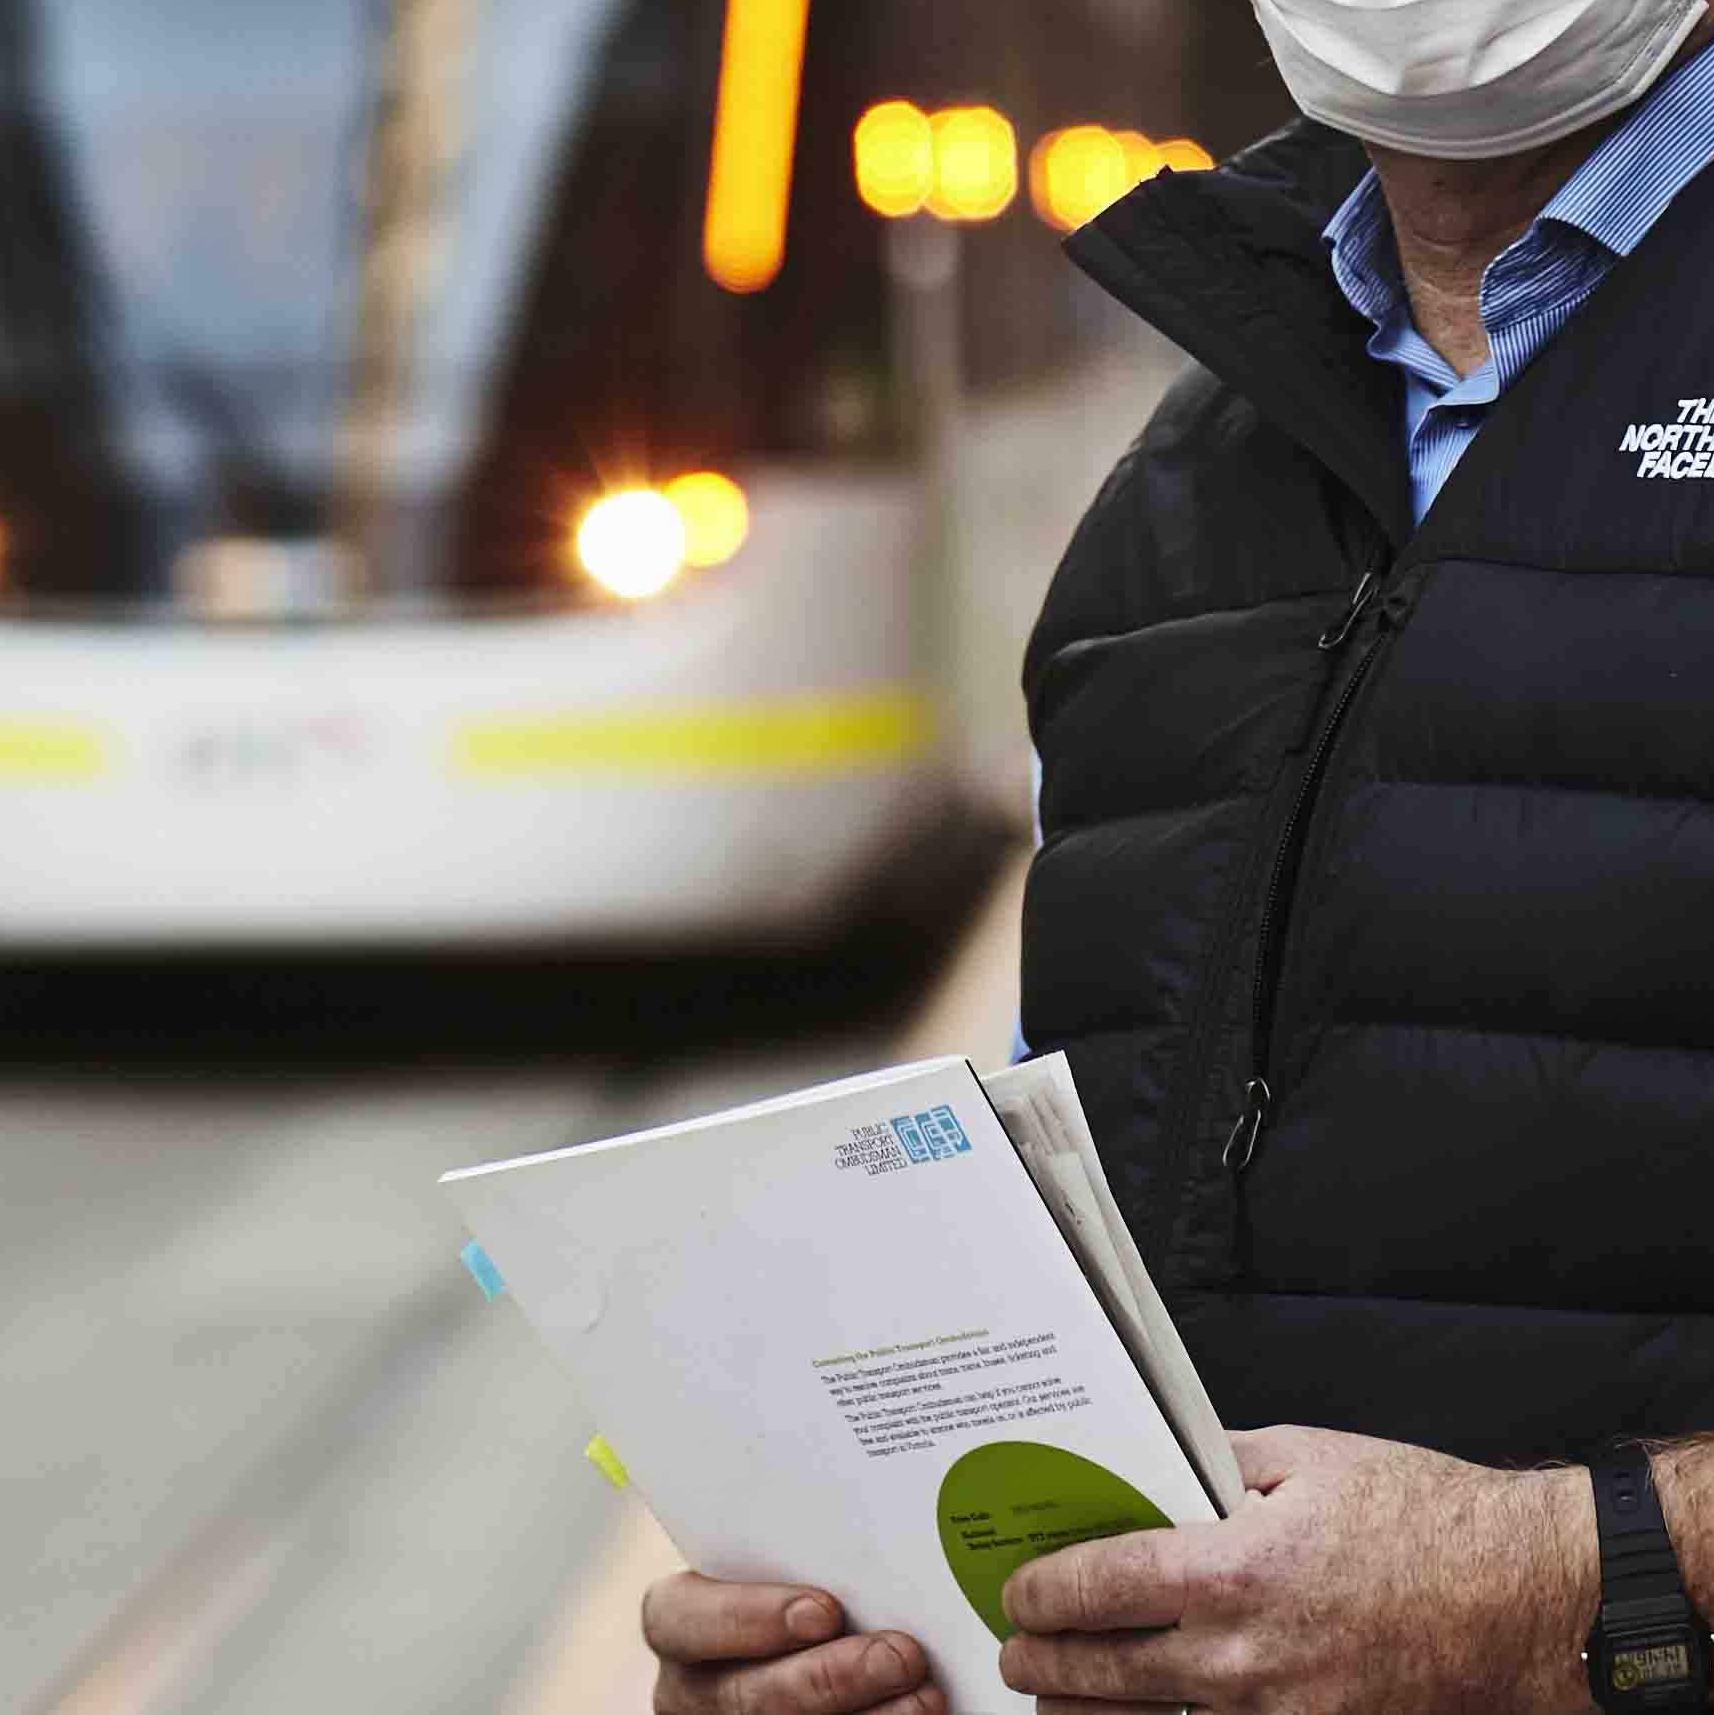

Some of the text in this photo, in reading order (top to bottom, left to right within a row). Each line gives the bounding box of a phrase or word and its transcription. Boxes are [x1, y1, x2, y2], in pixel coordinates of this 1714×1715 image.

[1637, 451, 1712, 479] FACE
[852, 1122, 890, 1141] PUBLIC
[834, 1134, 895, 1157] TRANSPORT
[835, 1146, 902, 1170] OMBUDSMAN
[865, 1158, 909, 1176] LIMITED
